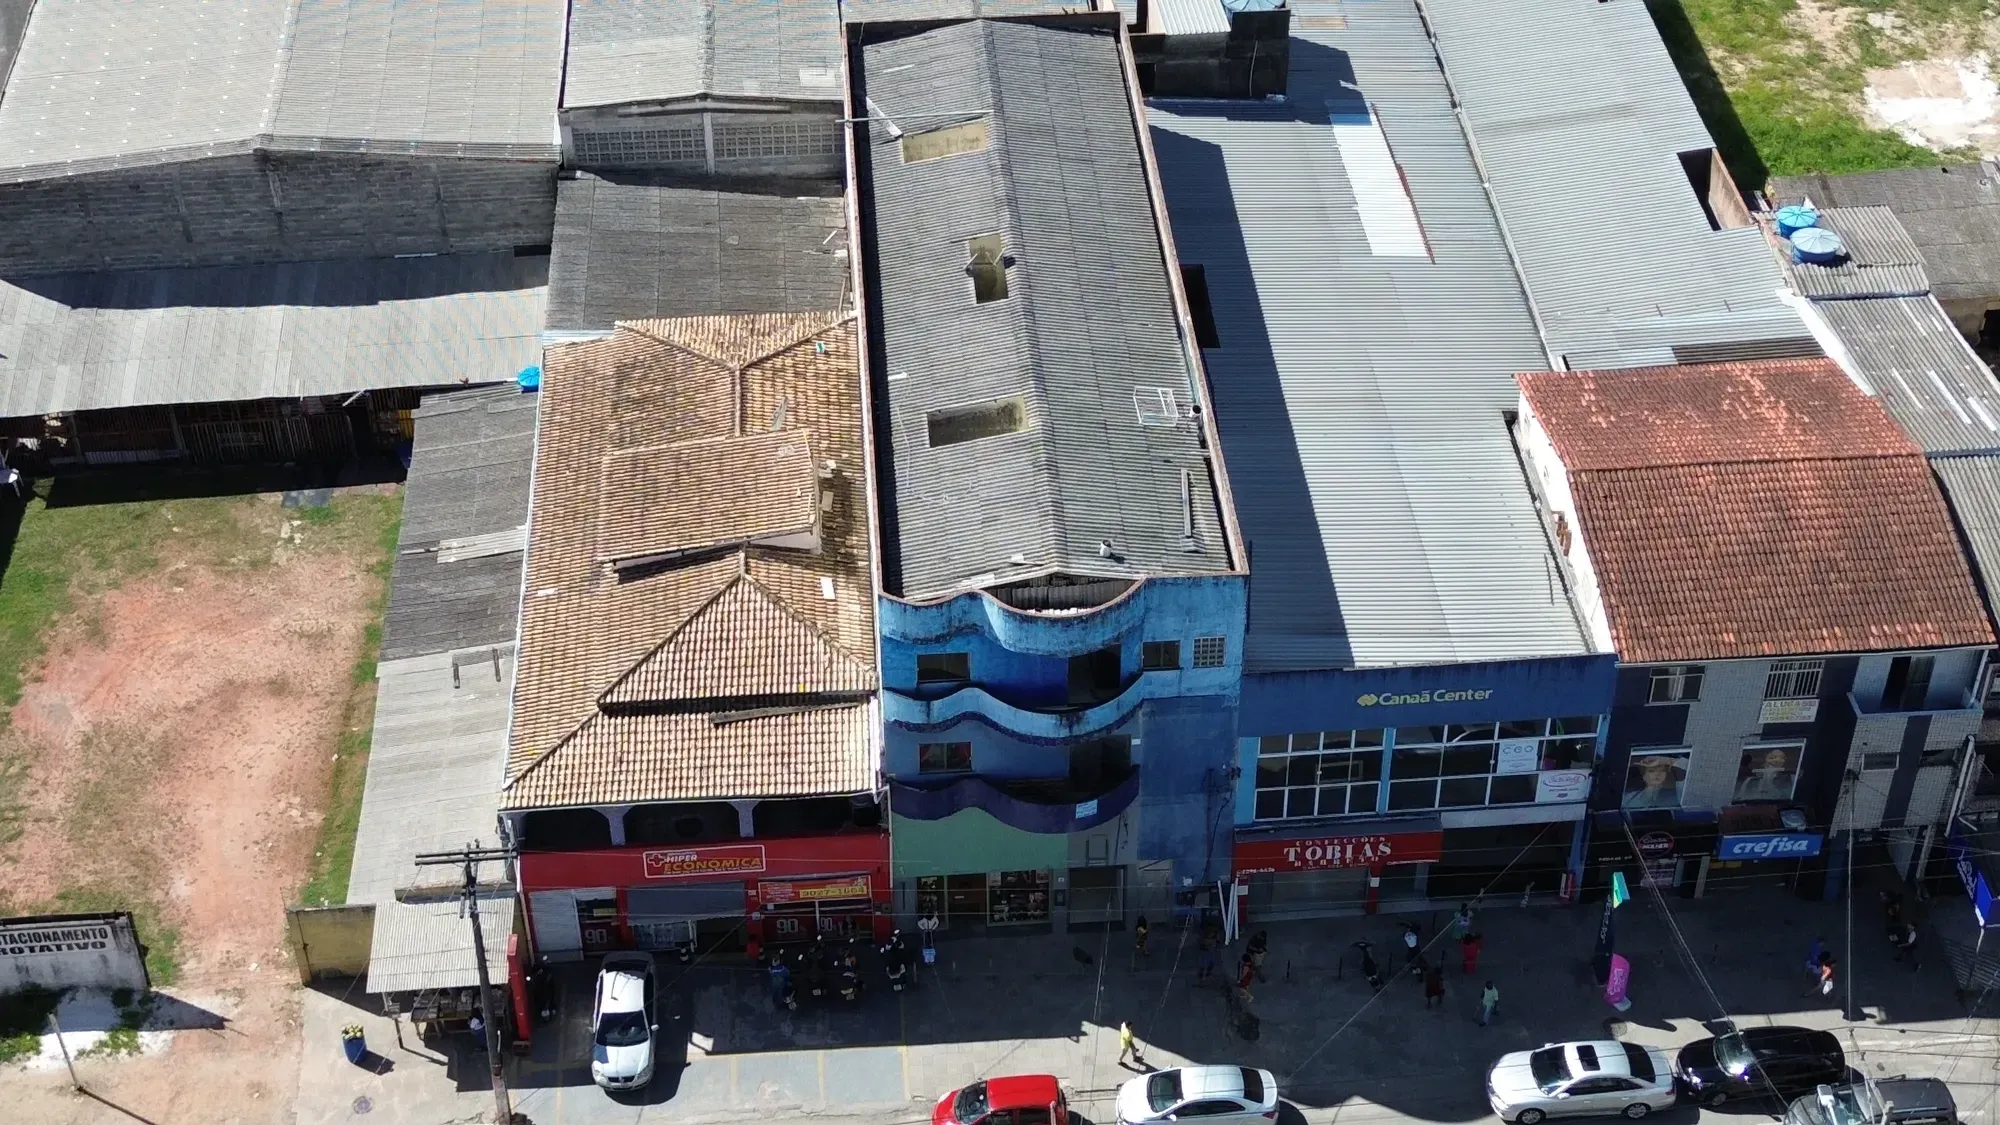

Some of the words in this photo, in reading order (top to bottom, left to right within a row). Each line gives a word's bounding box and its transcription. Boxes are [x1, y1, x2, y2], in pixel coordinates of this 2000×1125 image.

[1379, 690, 1430, 706] Canaã
[1433, 689, 1493, 702] Center
[1283, 841, 1392, 862] TOBIAS
[1733, 837, 1809, 857] crefisa
[665, 853, 698, 863] HIPER
[0, 927, 109, 946] TACIONAMENTO
